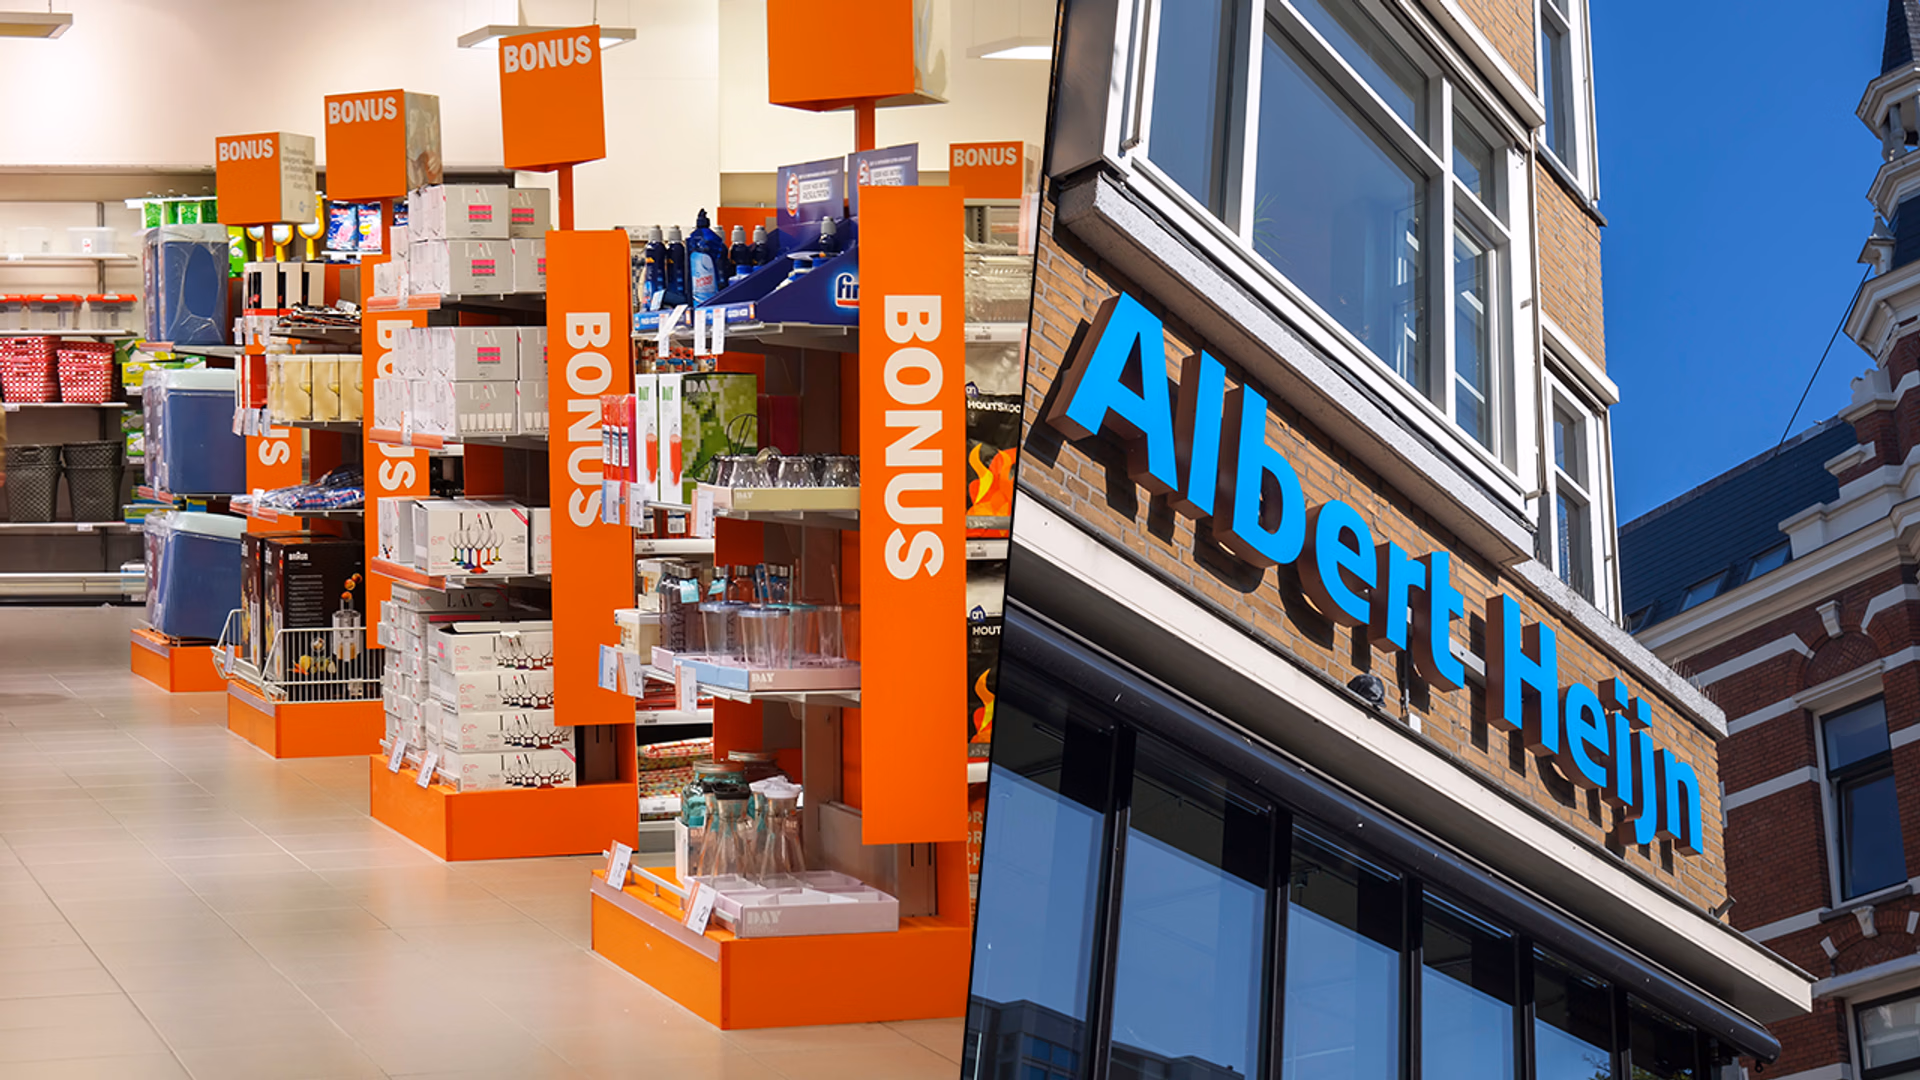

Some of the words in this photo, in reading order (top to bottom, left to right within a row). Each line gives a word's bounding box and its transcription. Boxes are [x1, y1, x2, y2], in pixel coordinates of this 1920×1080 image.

[504, 35, 592, 73] BONUS
[328, 97, 397, 124] BONUS
[219, 138, 273, 162] BONUS
[953, 146, 1017, 167] BONUS
[565, 312, 611, 527] BONUS
[884, 295, 944, 581] BONUS
[1065, 291, 1465, 691] Albert
[751, 673, 775, 683] DAY
[1502, 592, 1703, 855] Heijn
[746, 910, 782, 924] DAY
